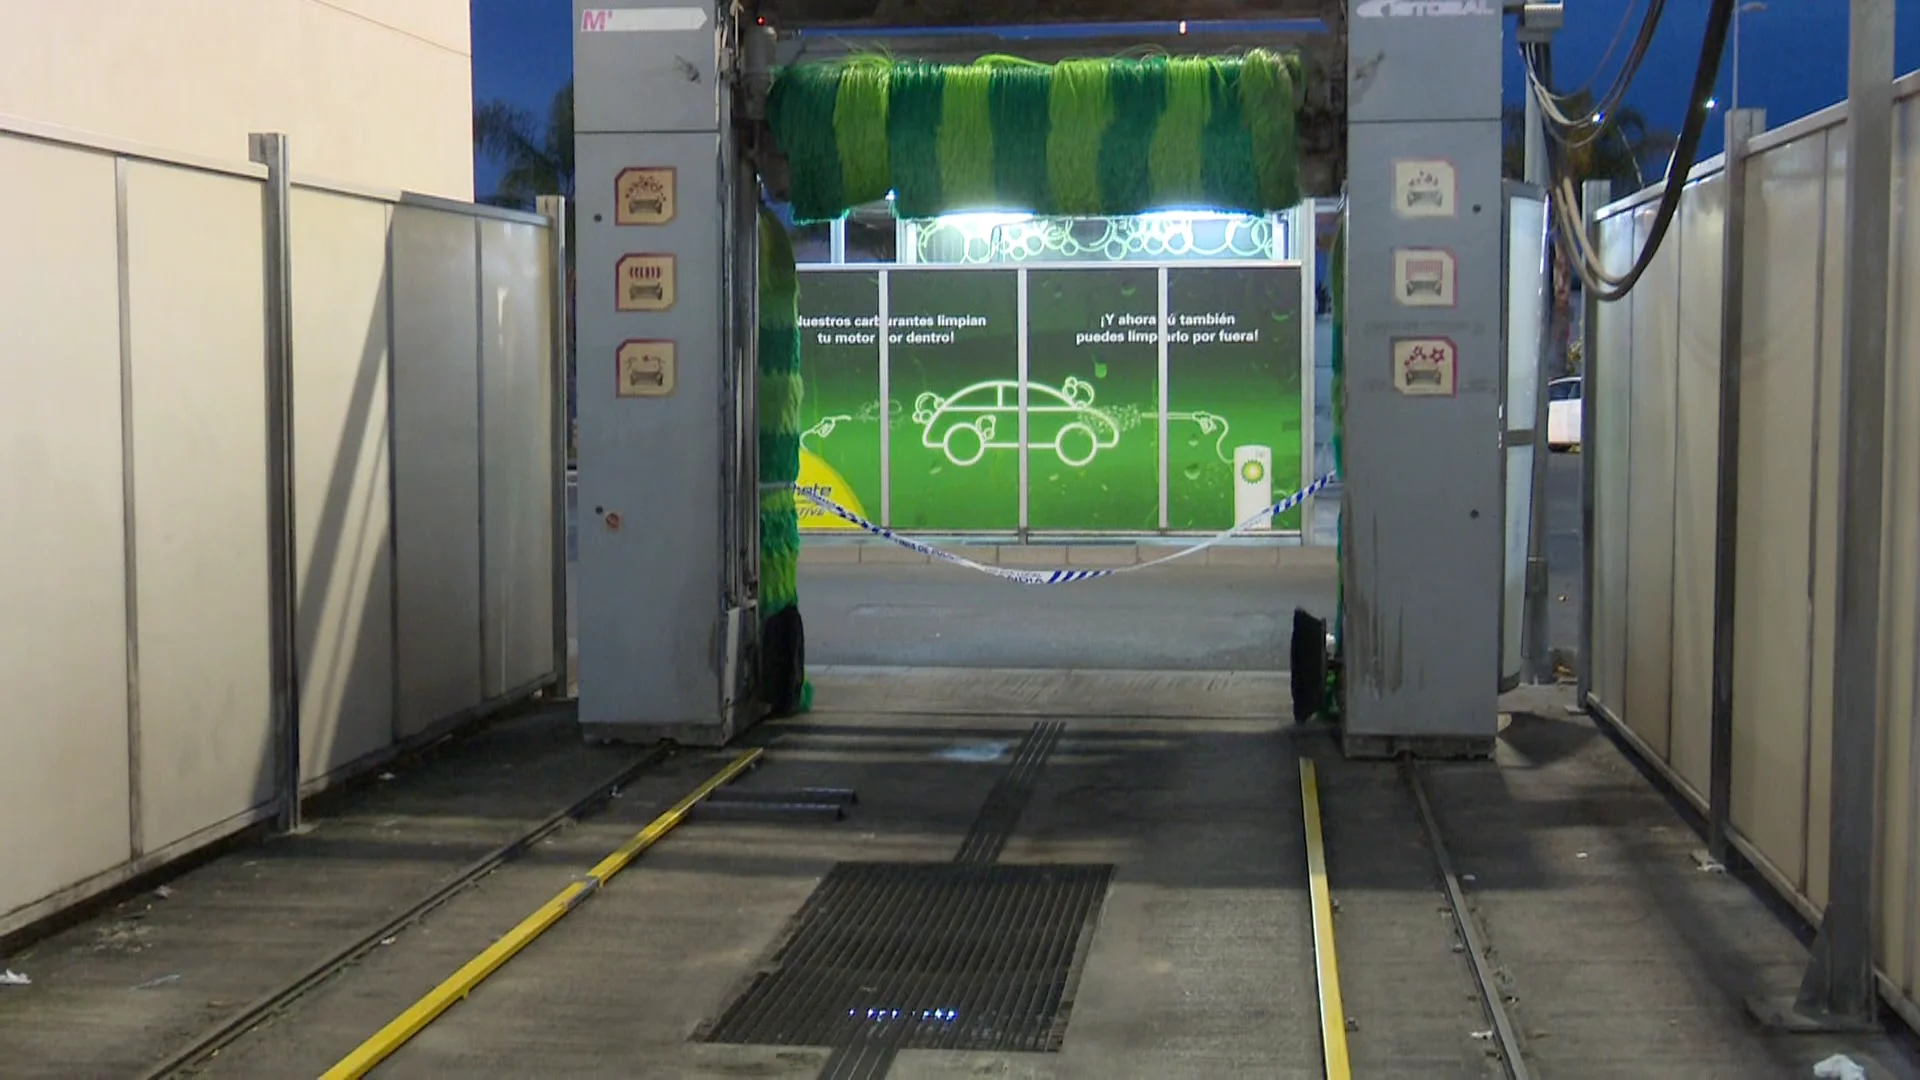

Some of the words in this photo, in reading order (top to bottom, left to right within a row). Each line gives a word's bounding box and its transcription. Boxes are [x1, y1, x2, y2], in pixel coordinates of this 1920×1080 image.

[938, 314, 987, 329] limpian
[1118, 313, 1157, 326] ahora
[1179, 312, 1236, 326] también
[817, 332, 831, 344] tu
[835, 332, 876, 344] motor
[906, 331, 955, 345] dentro!
[1076, 329, 1125, 345] puedes
[1128, 329, 1189, 345] limprlo
[1193, 334, 1216, 346] por
[1219, 328, 1259, 343] fuera!
